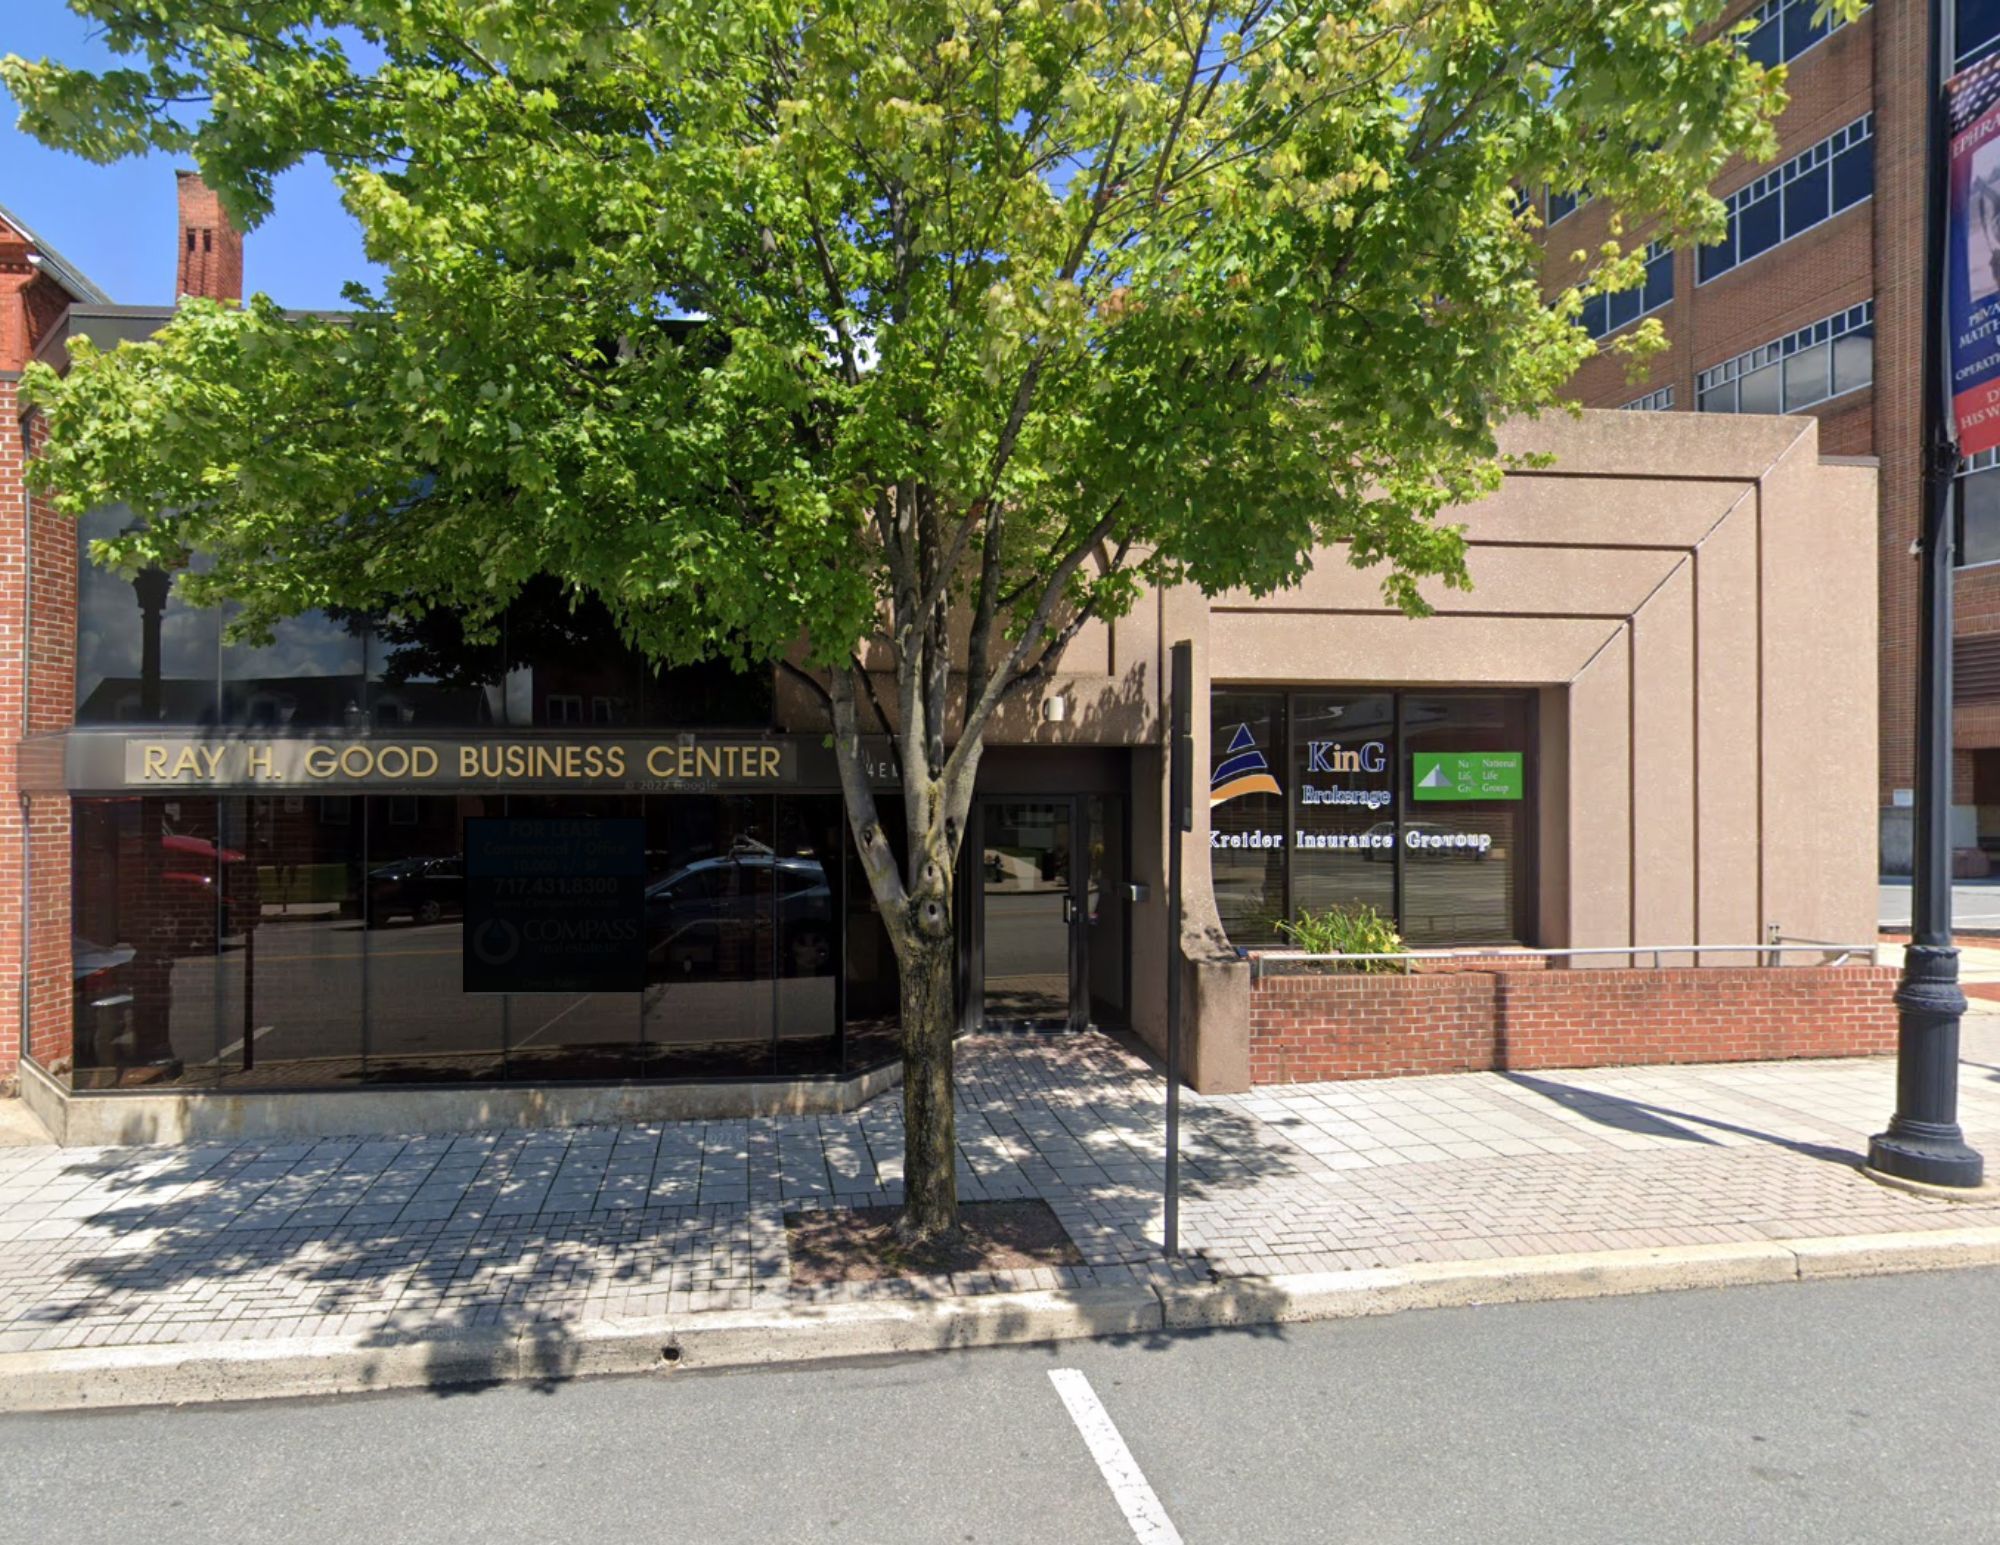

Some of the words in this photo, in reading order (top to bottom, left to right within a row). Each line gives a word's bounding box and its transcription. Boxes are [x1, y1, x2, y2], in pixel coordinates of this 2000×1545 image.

[1953, 112, 2000, 159] EPHRA
[1959, 318, 2000, 349] MATTH
[1961, 408, 1985, 430] HIS
[1984, 402, 2000, 418] W
[144, 745, 226, 778] RAY
[248, 745, 282, 778] H.
[303, 745, 440, 778] GOOD
[458, 745, 626, 778] BUSINESS
[645, 745, 782, 778] CENTER
[1306, 741, 1386, 773] KinG
[1481, 759, 1517, 768] National
[1481, 771, 1498, 781] Life
[1301, 784, 1392, 809] Brokerage
[1481, 783, 1510, 795] Group
[508, 821, 545, 838] FOR
[551, 821, 602, 838] LEASE
[1209, 830, 1283, 848] Kreider
[1295, 830, 1394, 848] Insurance
[583, 839, 627, 856] Office
[493, 877, 619, 895] 717.431.8300
[522, 919, 639, 942] COMPASS
